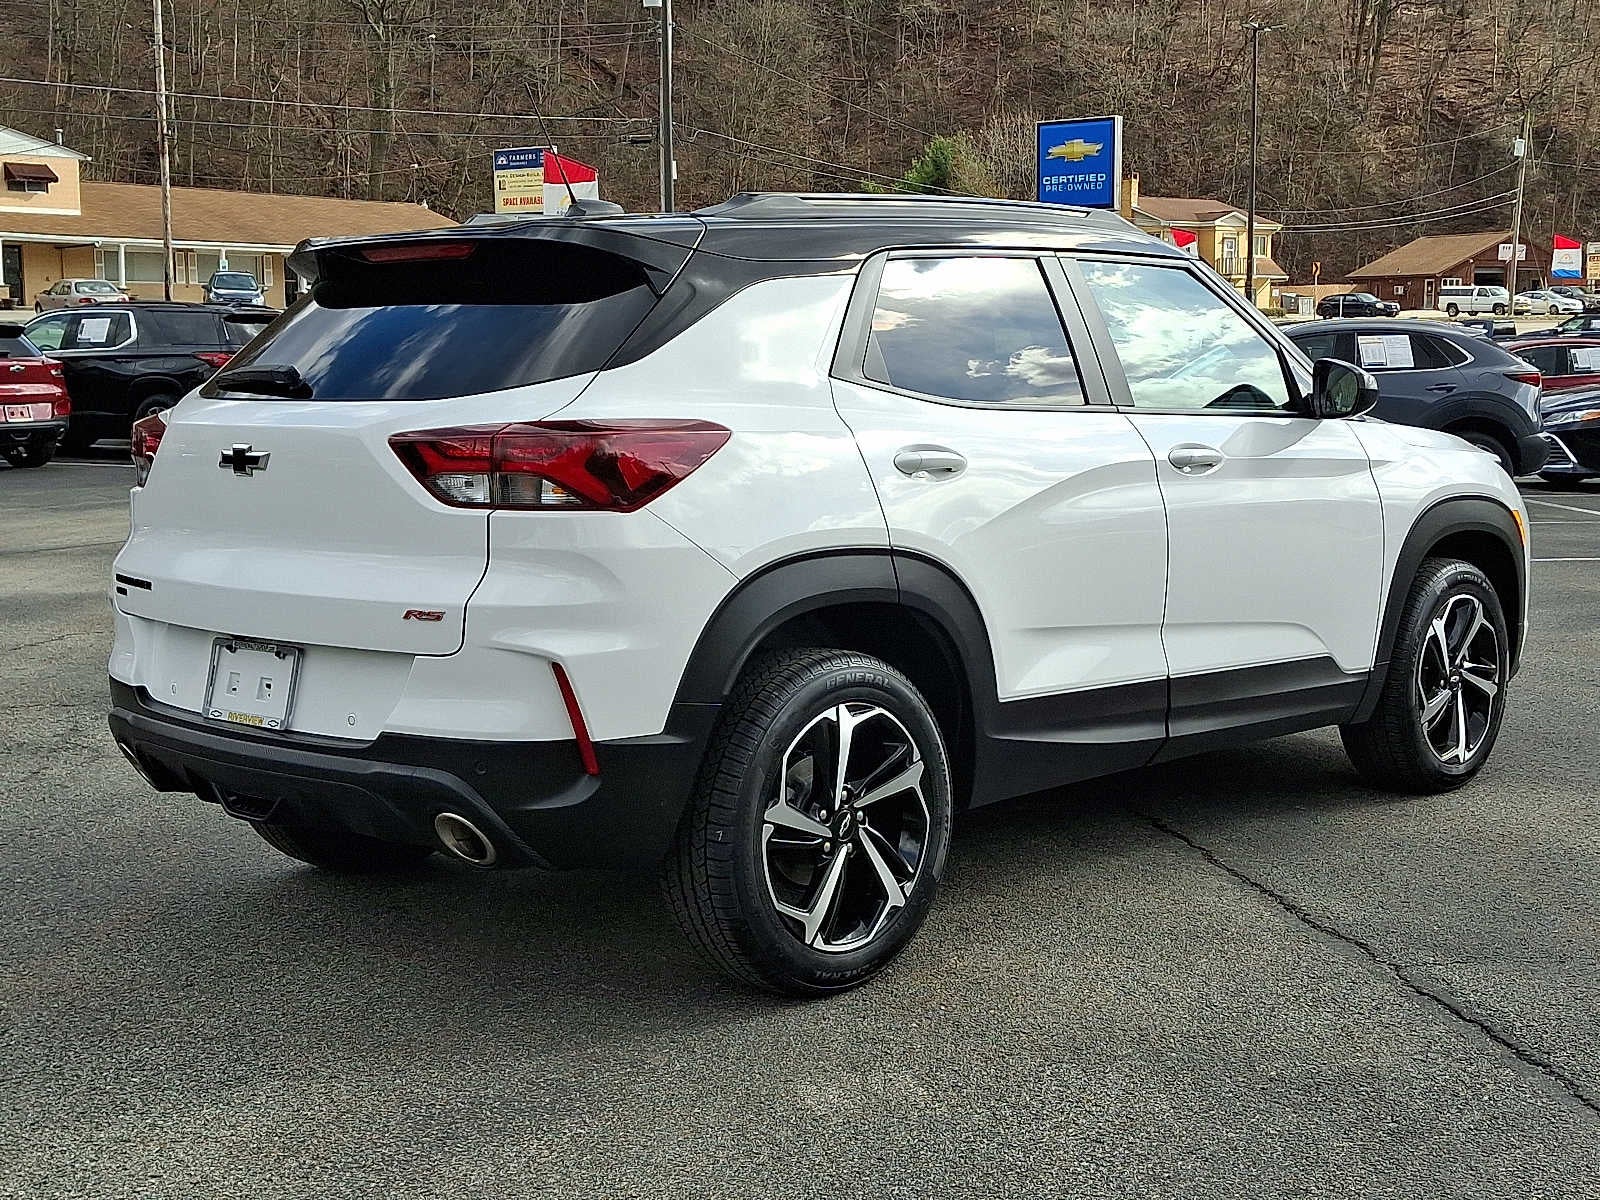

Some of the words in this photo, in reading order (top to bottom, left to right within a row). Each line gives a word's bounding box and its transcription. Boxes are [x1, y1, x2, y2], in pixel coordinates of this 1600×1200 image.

[509, 153, 536, 161] FARMERS
[1042, 173, 1106, 185] CERTIFIED
[1045, 182, 1103, 193] PRE-OWNED
[519, 196, 544, 205] AVAILABL
[402, 609, 446, 622] RS
[825, 672, 892, 690] GENERAL
[227, 711, 265, 725] RIVERVIEW
